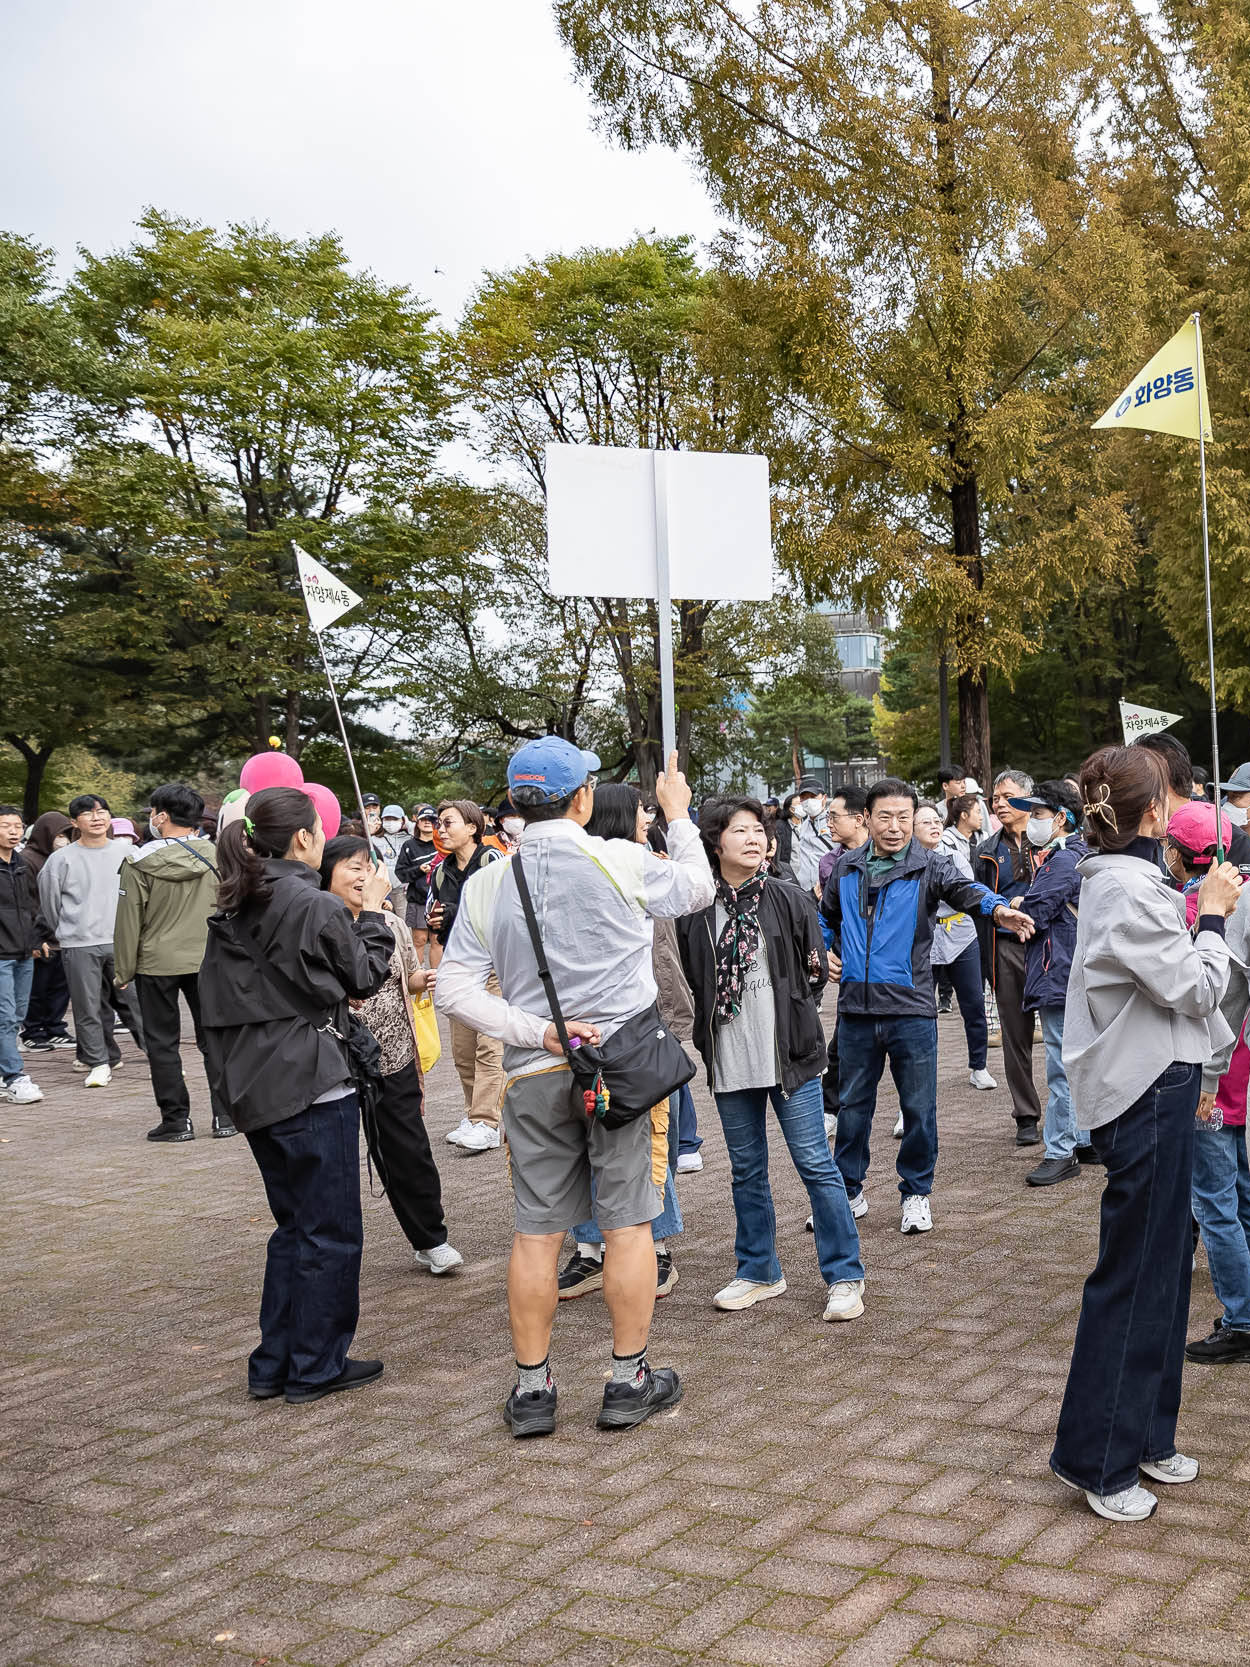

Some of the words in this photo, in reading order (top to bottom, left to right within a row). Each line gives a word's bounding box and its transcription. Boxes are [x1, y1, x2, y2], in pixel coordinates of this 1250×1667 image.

[1134, 367, 1195, 408] 화양동
[305, 585, 350, 607] 자양제4동
[1125, 715, 1169, 731] 자양제4동
